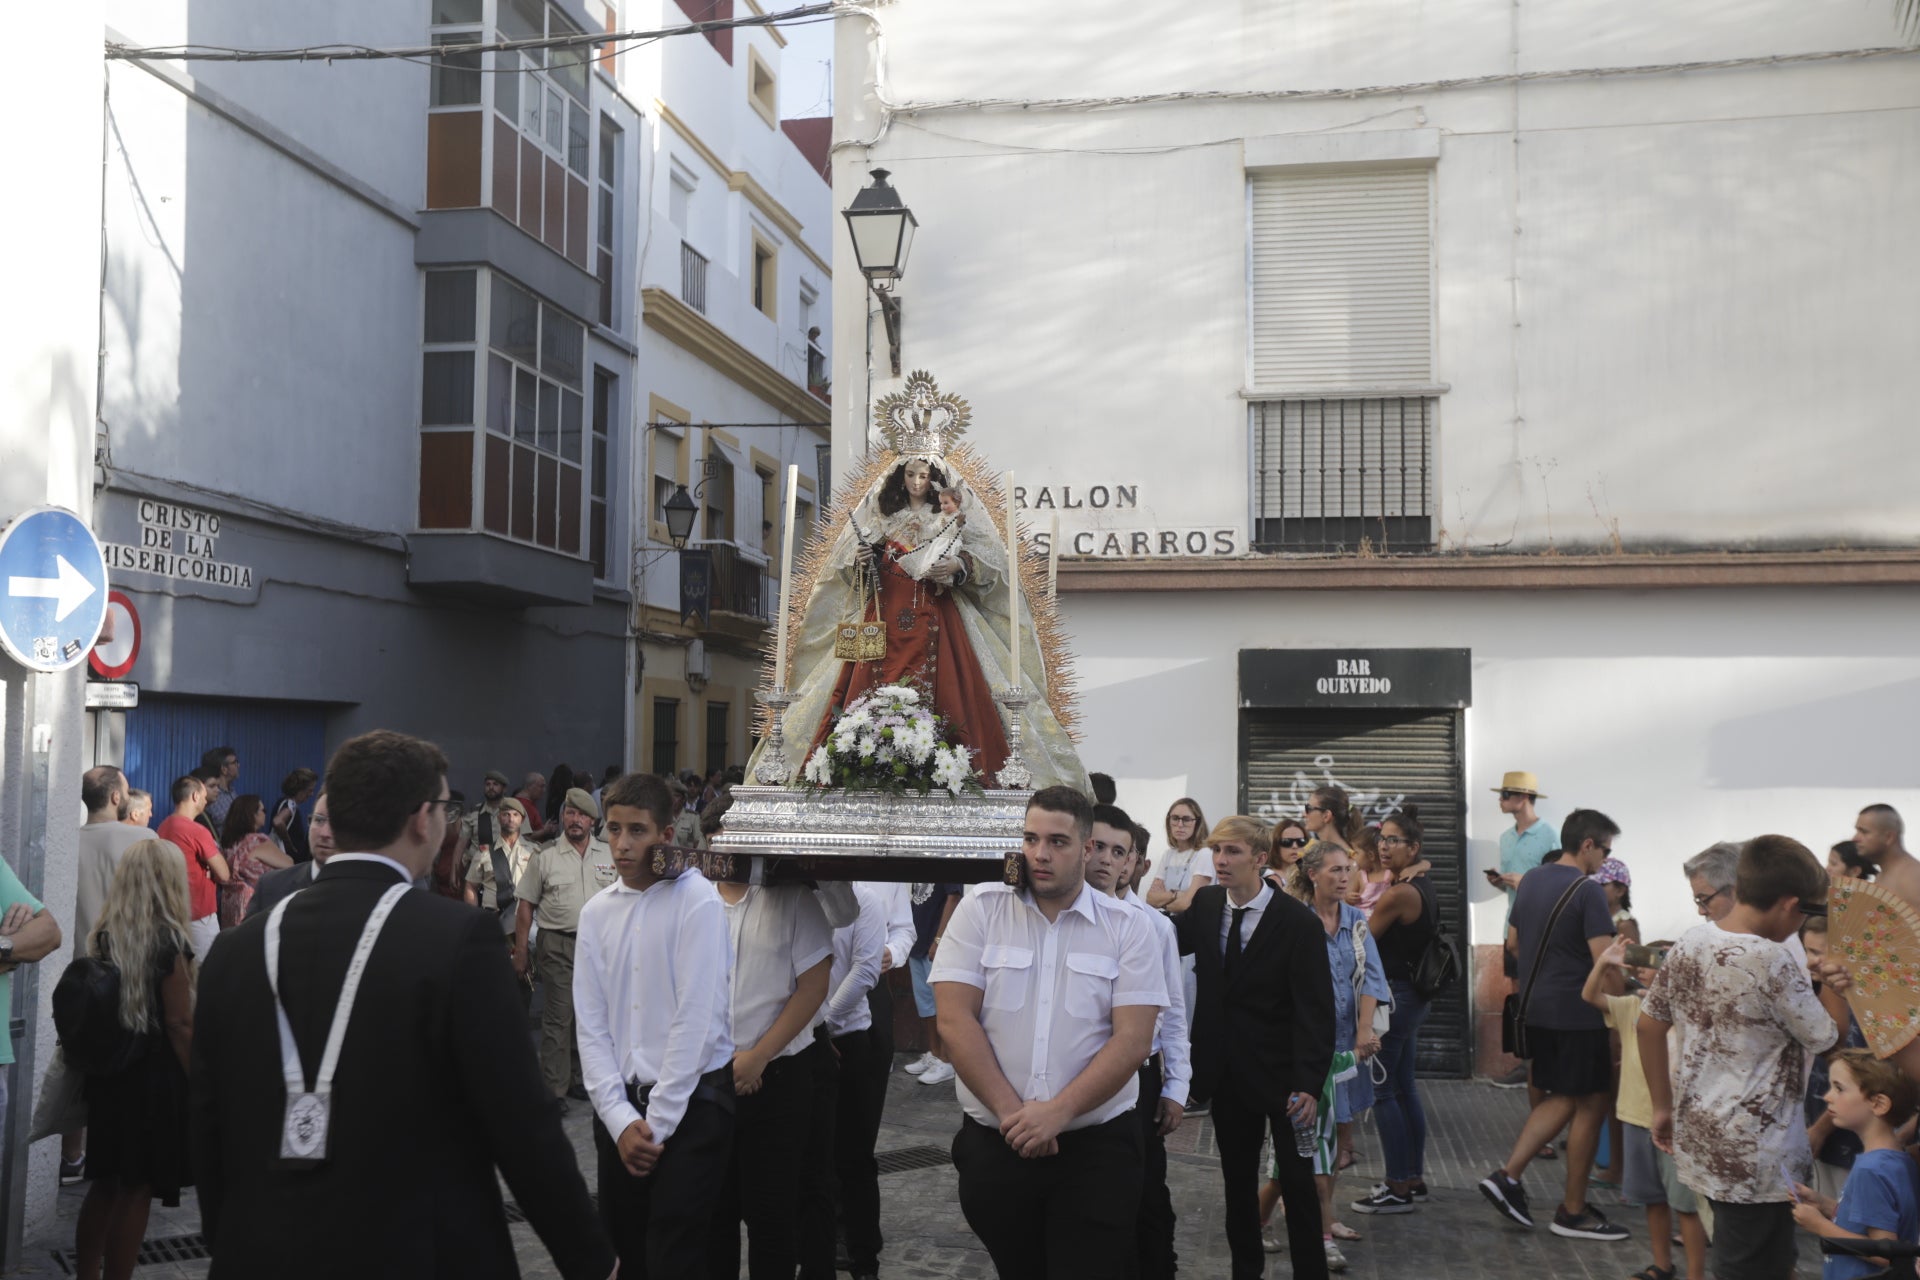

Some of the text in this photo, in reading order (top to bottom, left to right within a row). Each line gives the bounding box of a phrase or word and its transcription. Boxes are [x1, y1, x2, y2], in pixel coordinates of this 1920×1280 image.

[1014, 485, 1138, 509] RALON
[140, 501, 220, 534] CRISTO
[143, 527, 213, 559] DE LA
[1073, 530, 1236, 555] CARROS
[1336, 659, 1371, 676] BAR
[1316, 678, 1392, 694] QUEVEDO
